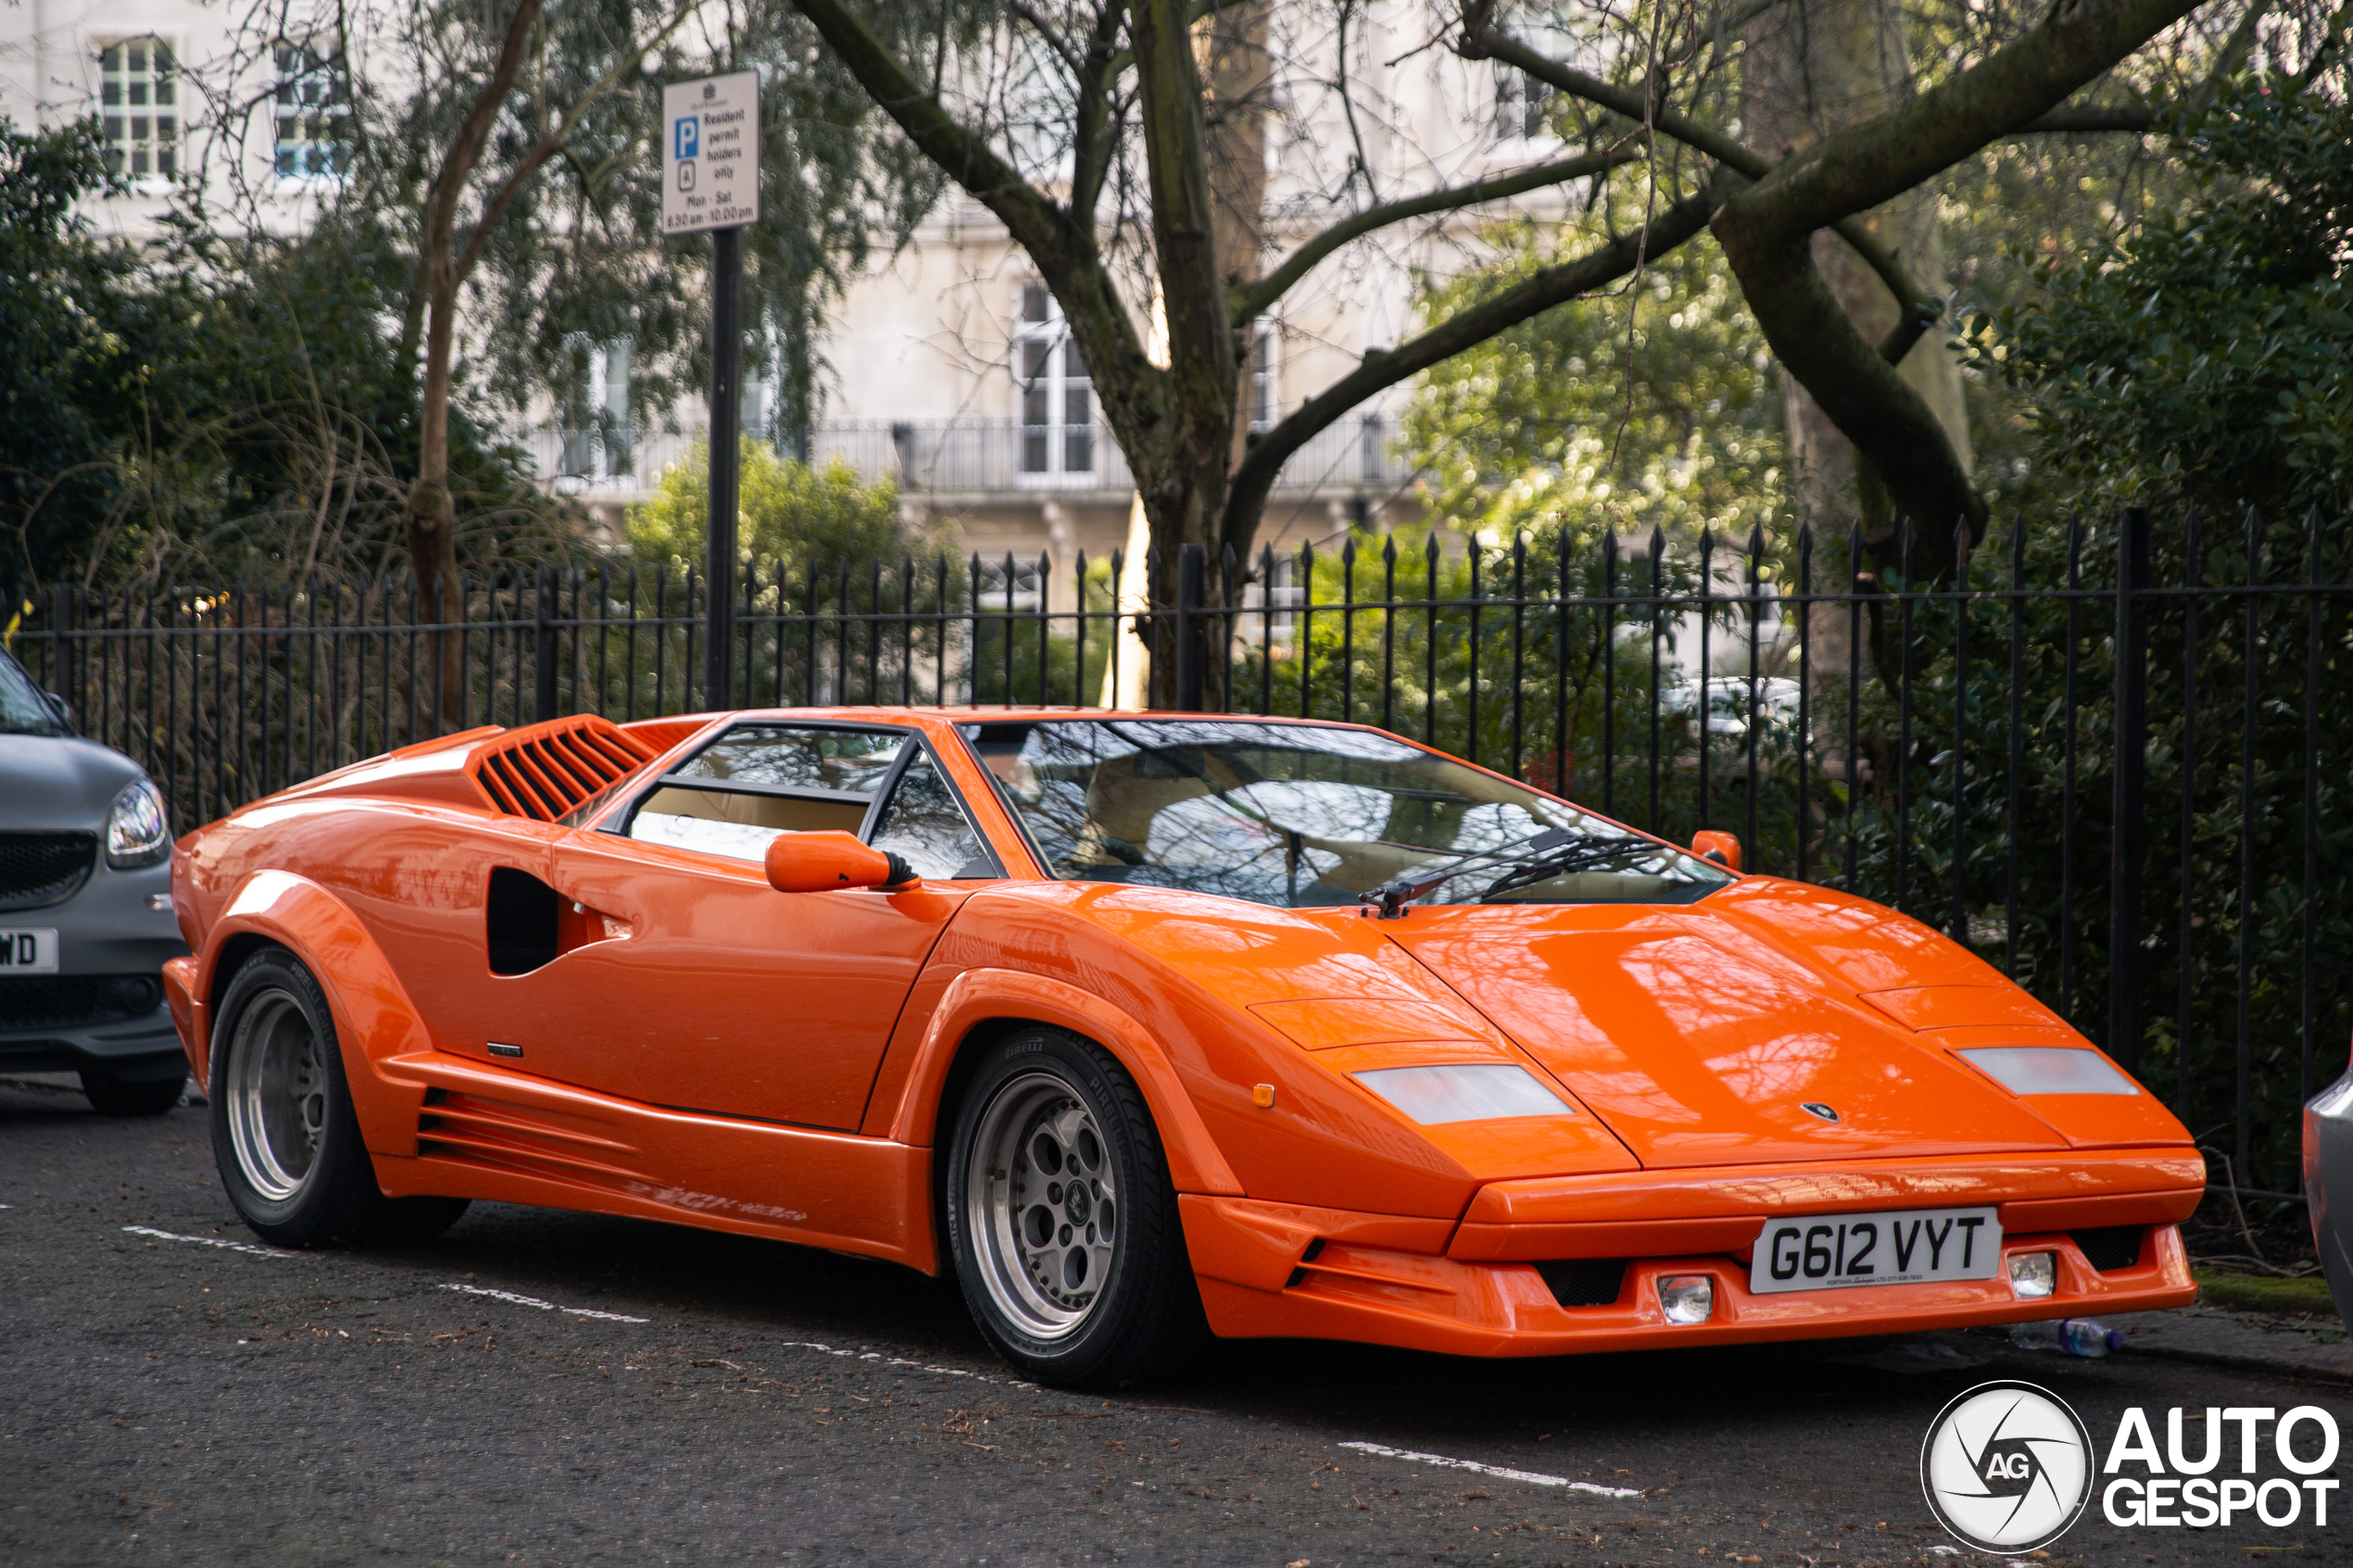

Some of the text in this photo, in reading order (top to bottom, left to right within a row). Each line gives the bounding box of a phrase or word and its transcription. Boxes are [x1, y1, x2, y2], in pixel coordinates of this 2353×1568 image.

[704, 107, 745, 126] Resident
[680, 119, 696, 157] P
[709, 127, 740, 146] permit
[707, 146, 742, 162] holders
[713, 164, 735, 180] only
[686, 194, 707, 207] Mon
[715, 190, 732, 205] Sat
[689, 213, 704, 225] am
[738, 207, 753, 220] pm
[289, 960, 321, 1006] PIRELLI
[1005, 1036, 1044, 1059] PIRELLI
[1089, 1075, 1127, 1149] PIRELLI
[1770, 1216, 1985, 1280] G612 VYT
